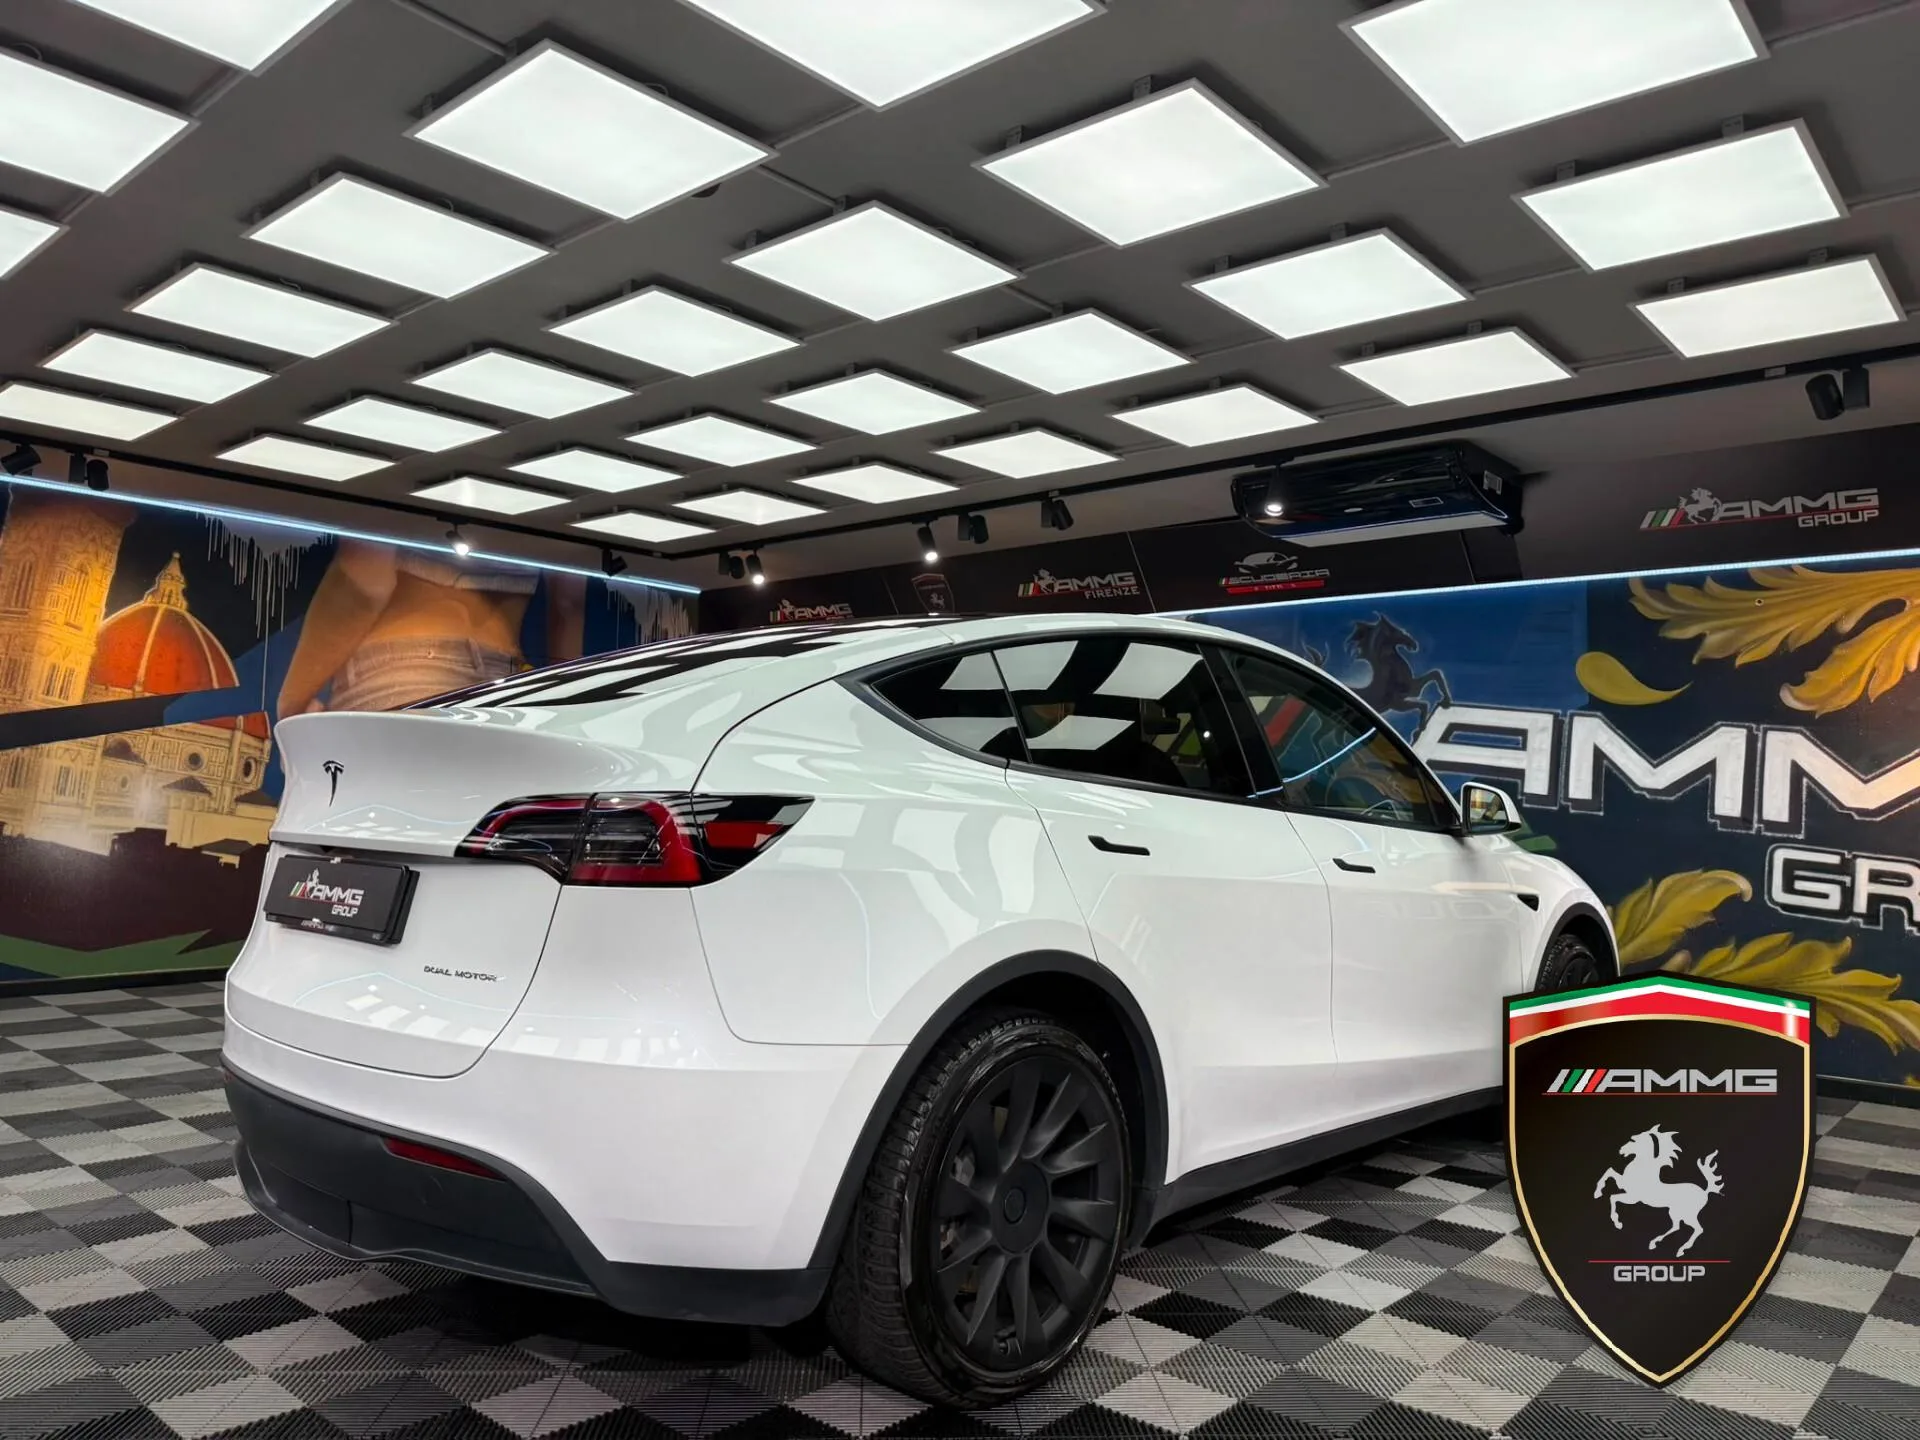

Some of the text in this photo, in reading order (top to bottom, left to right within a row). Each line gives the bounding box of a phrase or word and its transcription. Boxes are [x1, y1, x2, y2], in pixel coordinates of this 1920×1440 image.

[1713, 488, 1879, 521] AMMG
[1798, 510, 1880, 528] GROUP
[1053, 571, 1137, 593] AMMG
[1084, 586, 1140, 600] FIRENZE
[795, 603, 853, 619] AMMG
[1770, 847, 1920, 923] GR
[310, 884, 365, 906] AMMG
[331, 904, 359, 917] GROUP
[423, 965, 497, 982] DUAL MOTOR
[1594, 1068, 1778, 1093] AMMG
[1613, 1265, 1706, 1282] GROUP
